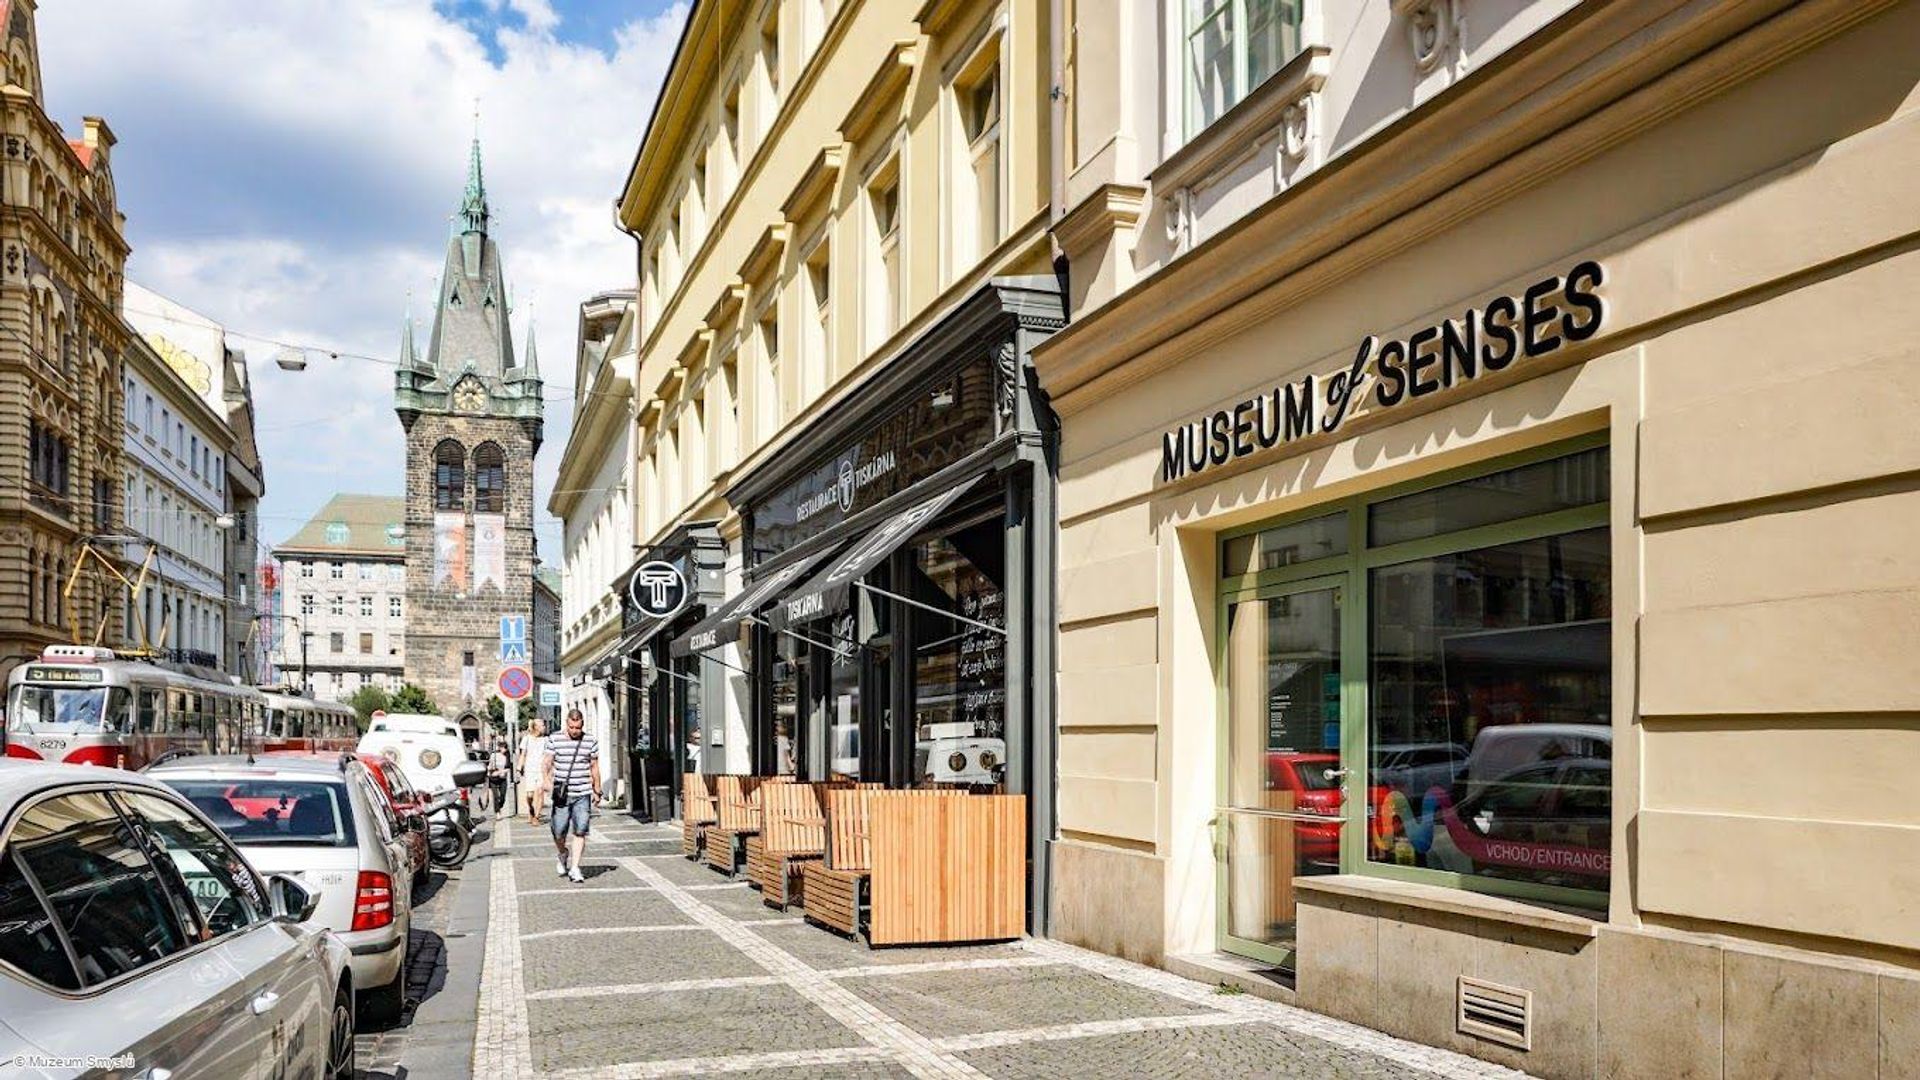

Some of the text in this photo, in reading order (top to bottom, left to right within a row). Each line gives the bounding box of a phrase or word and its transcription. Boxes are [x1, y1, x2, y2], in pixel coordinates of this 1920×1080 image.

[1163, 261, 1604, 482] MUSEUM of SENSES
[797, 484, 838, 522] RESTAURACE
[855, 450, 896, 489] TISKÁRNA
[1486, 843, 1611, 871] VCHOD/ENTRANCE
